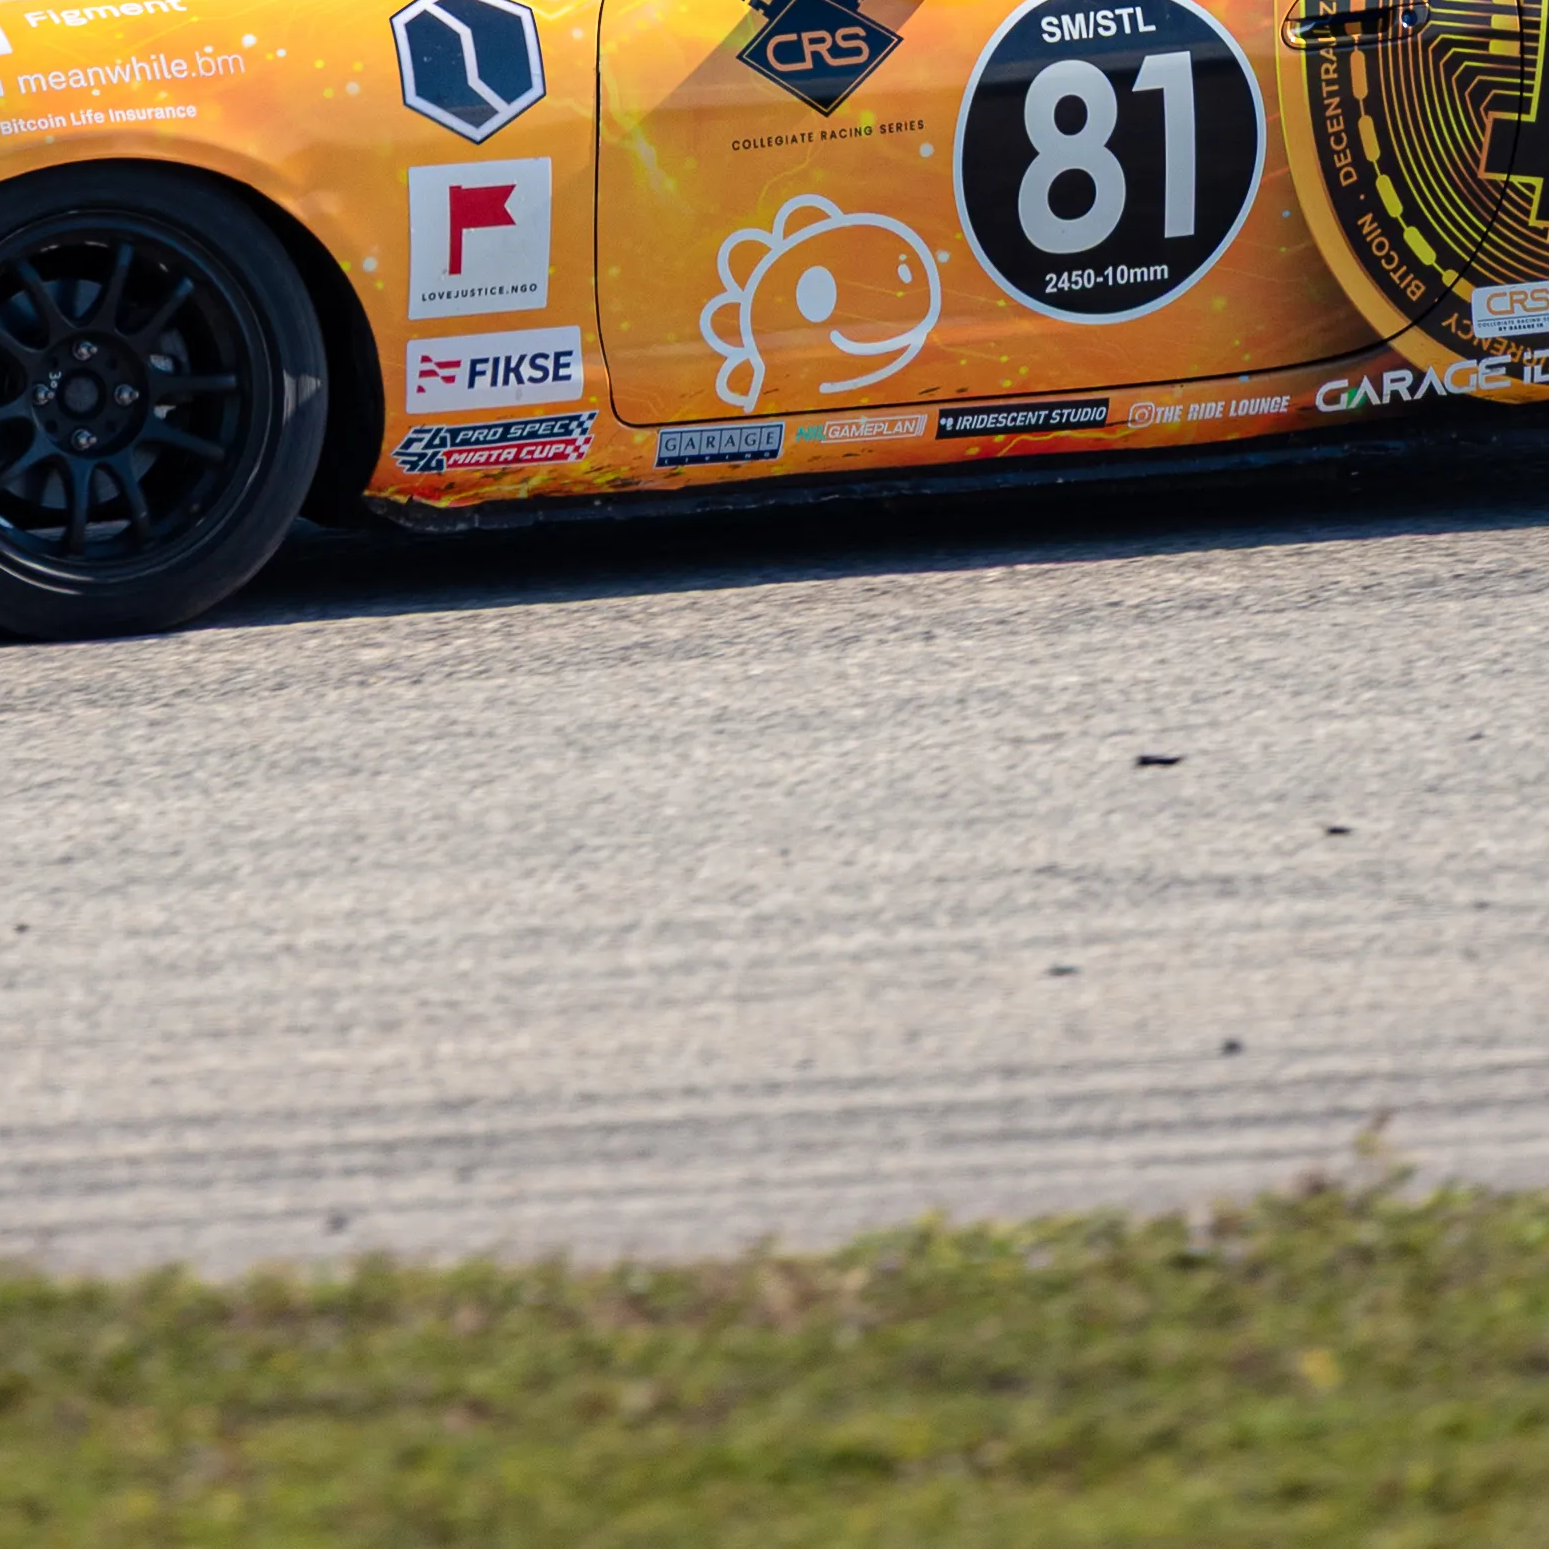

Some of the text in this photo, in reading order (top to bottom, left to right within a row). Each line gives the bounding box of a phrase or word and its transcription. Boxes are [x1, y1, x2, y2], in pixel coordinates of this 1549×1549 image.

[1041, 7, 1156, 43] SM/STL
[766, 27, 870, 72] CRS
[17, 51, 246, 94] meanwhile.bm
[0, 104, 197, 136] Bitcoin Life Insurance
[731, 119, 925, 151] COLLEGIATE RACING SERIES
[1018, 50, 1196, 254] 81
[1357, 213, 1426, 302] BITCOIN
[421, 283, 538, 302] LOVEJUSTICE.NGO
[1045, 263, 1169, 294] 2450-10mm
[467, 350, 574, 390] FIKSE
[1315, 354, 1512, 412] GARAGE
[955, 406, 1107, 430] IRIDESCENT STUDIO
[1154, 395, 1291, 423] THE RIDE LOUNGE
[455, 419, 572, 443] PRO SPEC
[664, 431, 775, 452] GARAGE
[828, 419, 916, 439] GAMEPLAN
[447, 443, 566, 466] MIATA CUP
